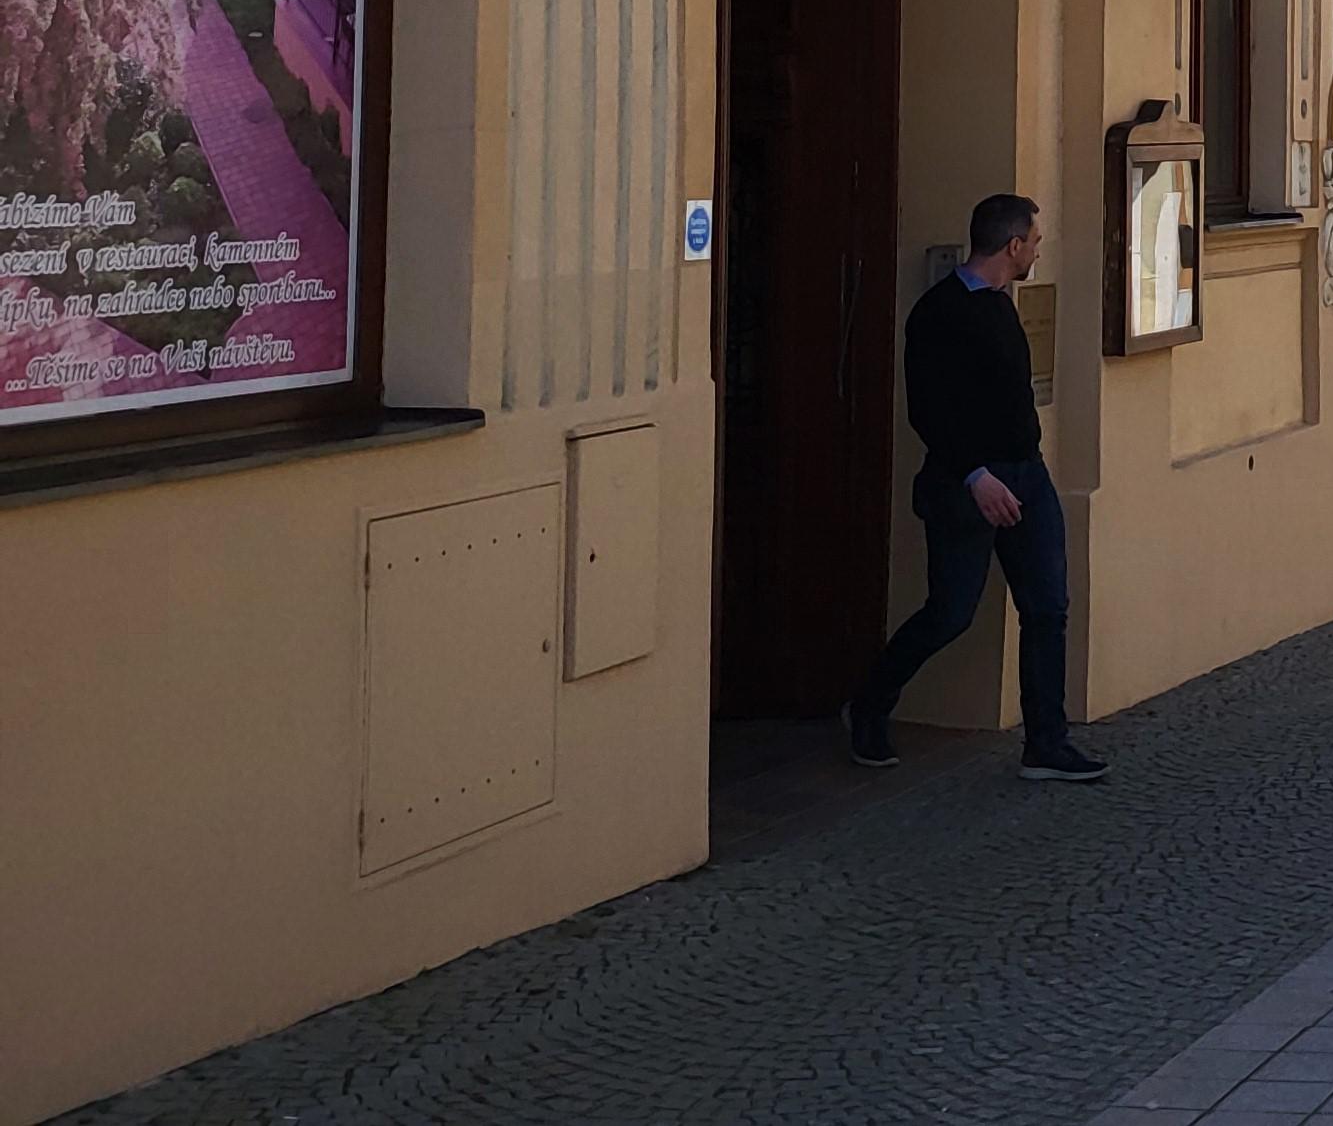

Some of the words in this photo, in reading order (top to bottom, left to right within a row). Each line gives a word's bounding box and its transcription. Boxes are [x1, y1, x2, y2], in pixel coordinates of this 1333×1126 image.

[0, 192, 81, 229] abízíme
[84, 190, 136, 228] Vám
[1, 240, 71, 277] sezení
[76, 248, 94, 275] v
[96, 235, 199, 272] restauraci,
[203, 231, 300, 272] kamenném
[64, 294, 93, 320] na
[95, 278, 186, 318] zahrádce
[190, 275, 235, 311] nebo
[103, 356, 126, 381] se
[128, 354, 157, 379] na
[160, 338, 208, 375] Vaši
[209, 333, 296, 371] návštěvu.
